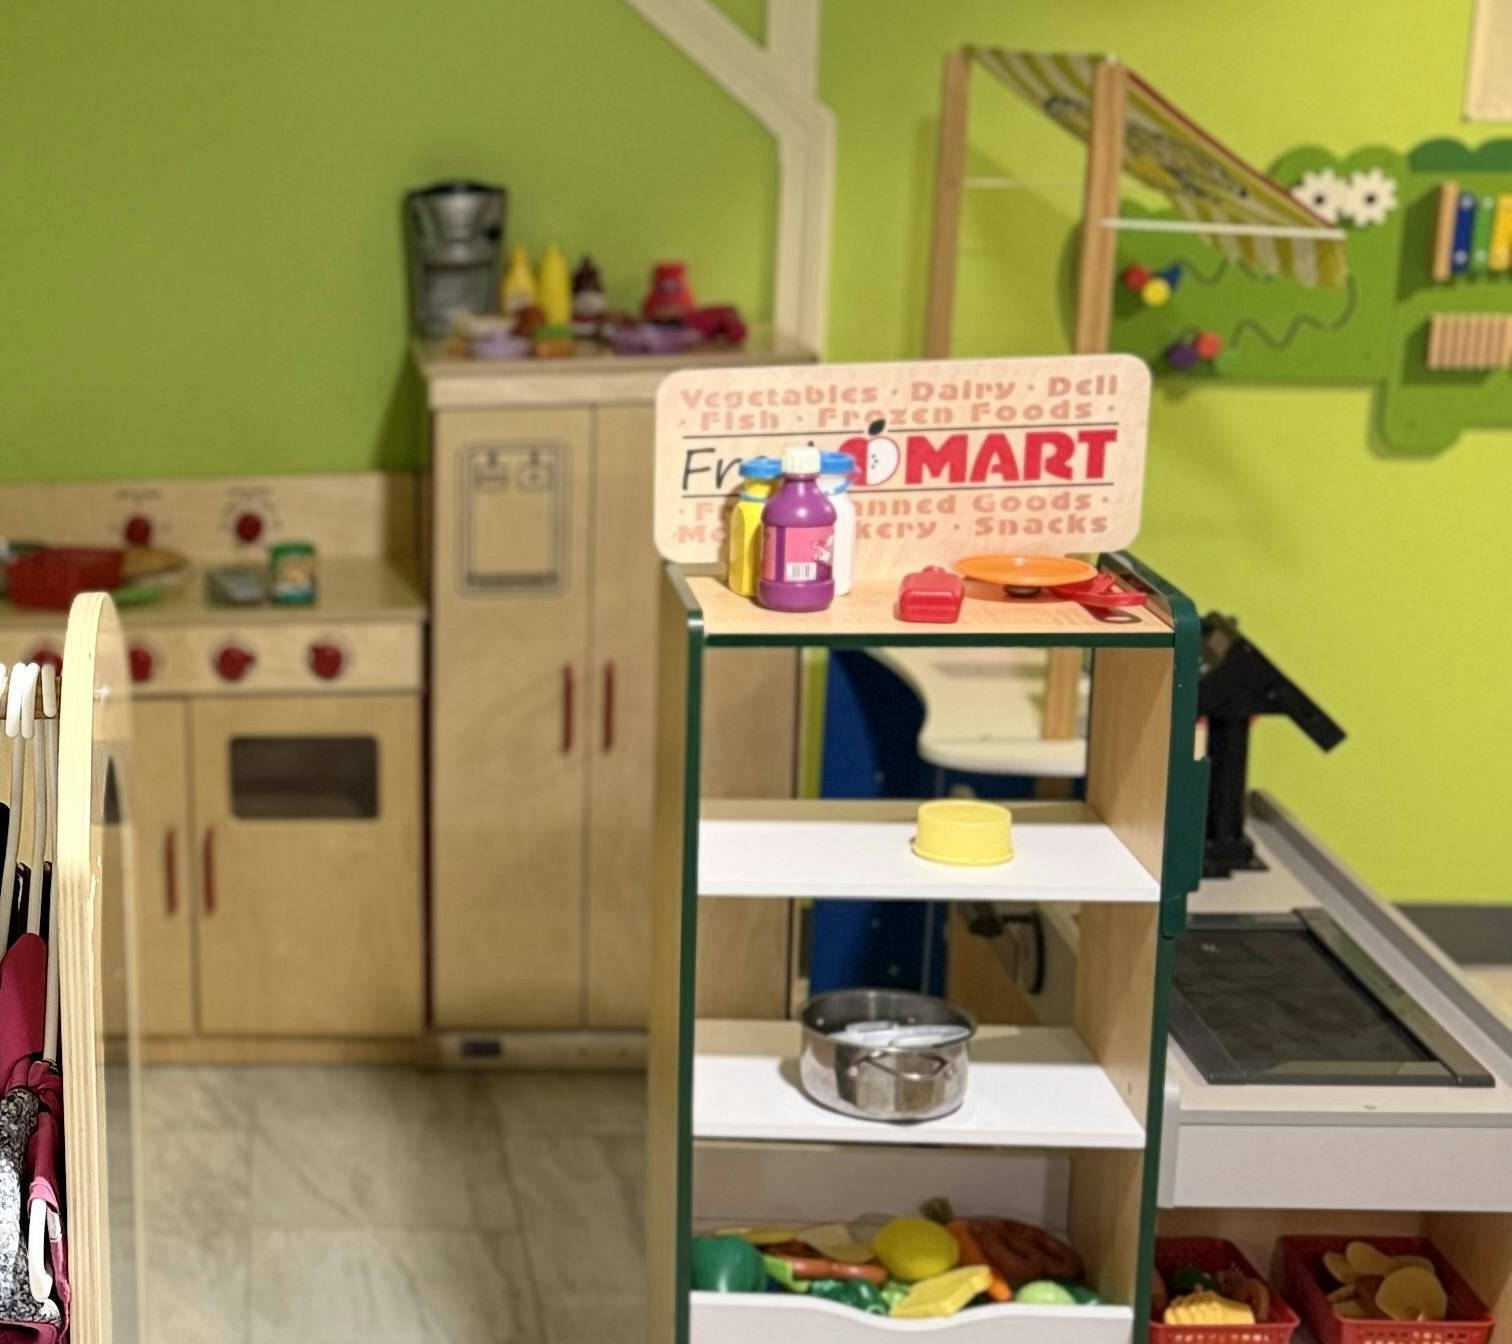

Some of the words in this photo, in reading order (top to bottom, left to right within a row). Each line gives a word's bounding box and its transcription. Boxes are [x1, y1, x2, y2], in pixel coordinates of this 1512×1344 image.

[680, 385, 879, 409] Vegetables
[910, 379, 1016, 401] Dairy
[1047, 374, 1118, 397] Deli
[700, 409, 780, 431] Fish
[817, 406, 953, 429] Frozen
[970, 399, 1093, 423] Foods
[905, 429, 1118, 485] MART
[855, 494, 956, 517] nned
[972, 491, 1093, 513] Goods
[855, 520, 937, 540] kery
[974, 513, 1108, 537] Snacks
